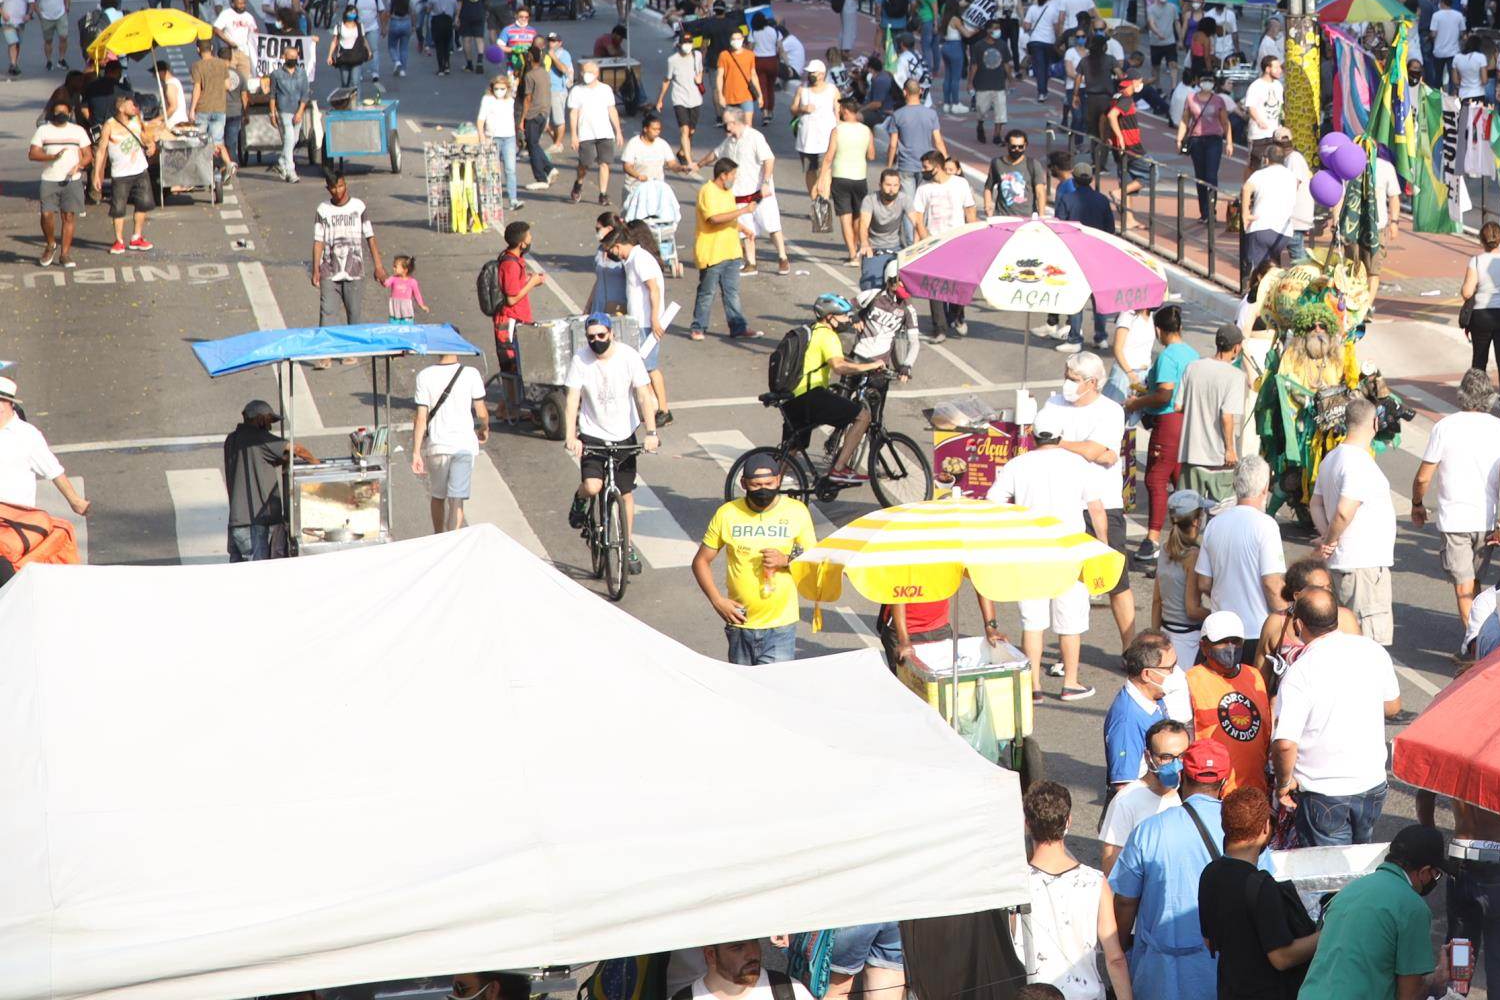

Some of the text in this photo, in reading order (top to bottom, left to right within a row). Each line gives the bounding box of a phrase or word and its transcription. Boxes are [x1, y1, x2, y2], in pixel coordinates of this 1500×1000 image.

[257, 36, 304, 60] FORA
[732, 525, 791, 538] BRASIL
[893, 585, 924, 599] SKOL
[1219, 692, 1251, 709] FORÇA
[1221, 720, 1261, 741] SINDICAL
